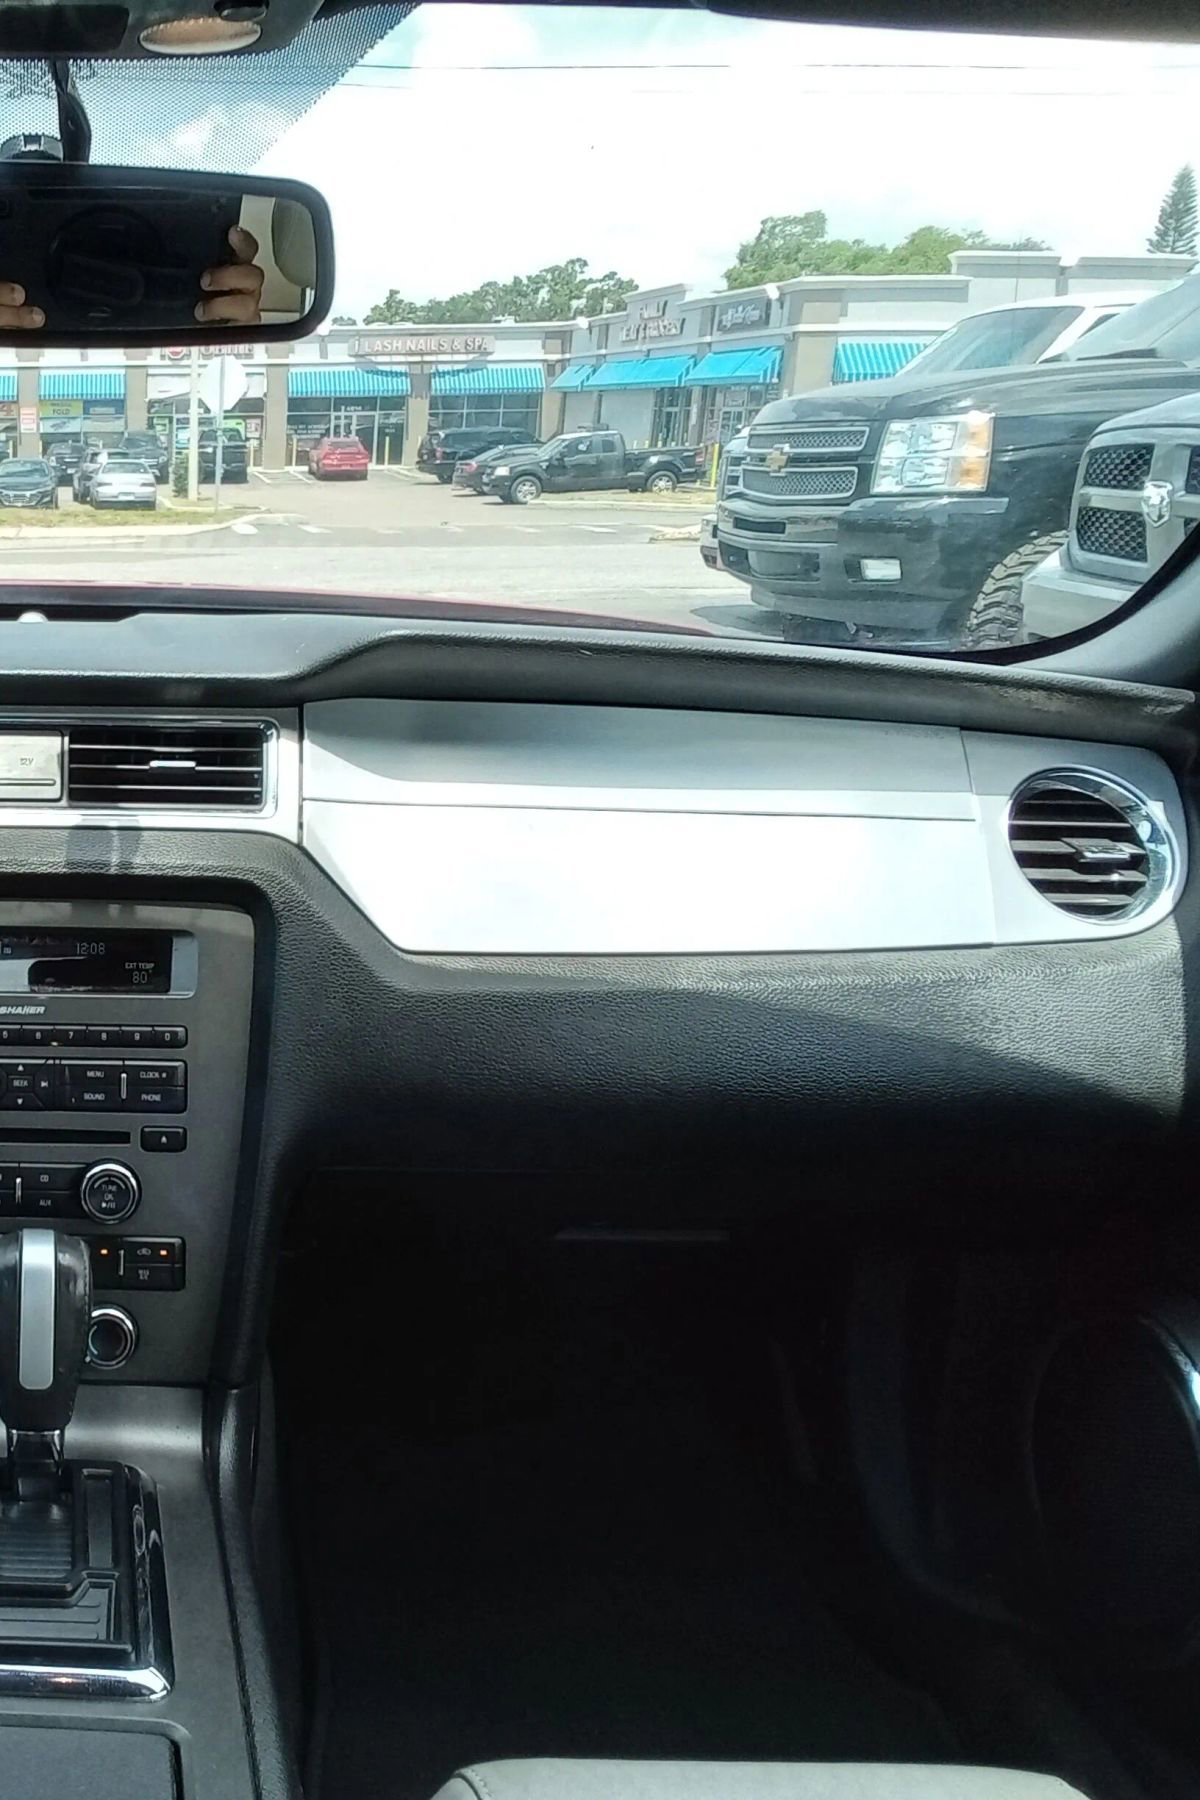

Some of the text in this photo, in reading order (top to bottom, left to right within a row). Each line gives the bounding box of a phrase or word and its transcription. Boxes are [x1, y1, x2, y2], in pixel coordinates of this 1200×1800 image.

[364, 339, 402, 352] LASH
[405, 338, 448, 351] NAILS
[451, 339, 463, 351] &
[465, 336, 489, 351] SPA
[86, 1070, 105, 1078] MENU
[83, 1092, 105, 1101] SOUND
[141, 1093, 162, 1102] PHONE
[39, 1174, 49, 1183] CD
